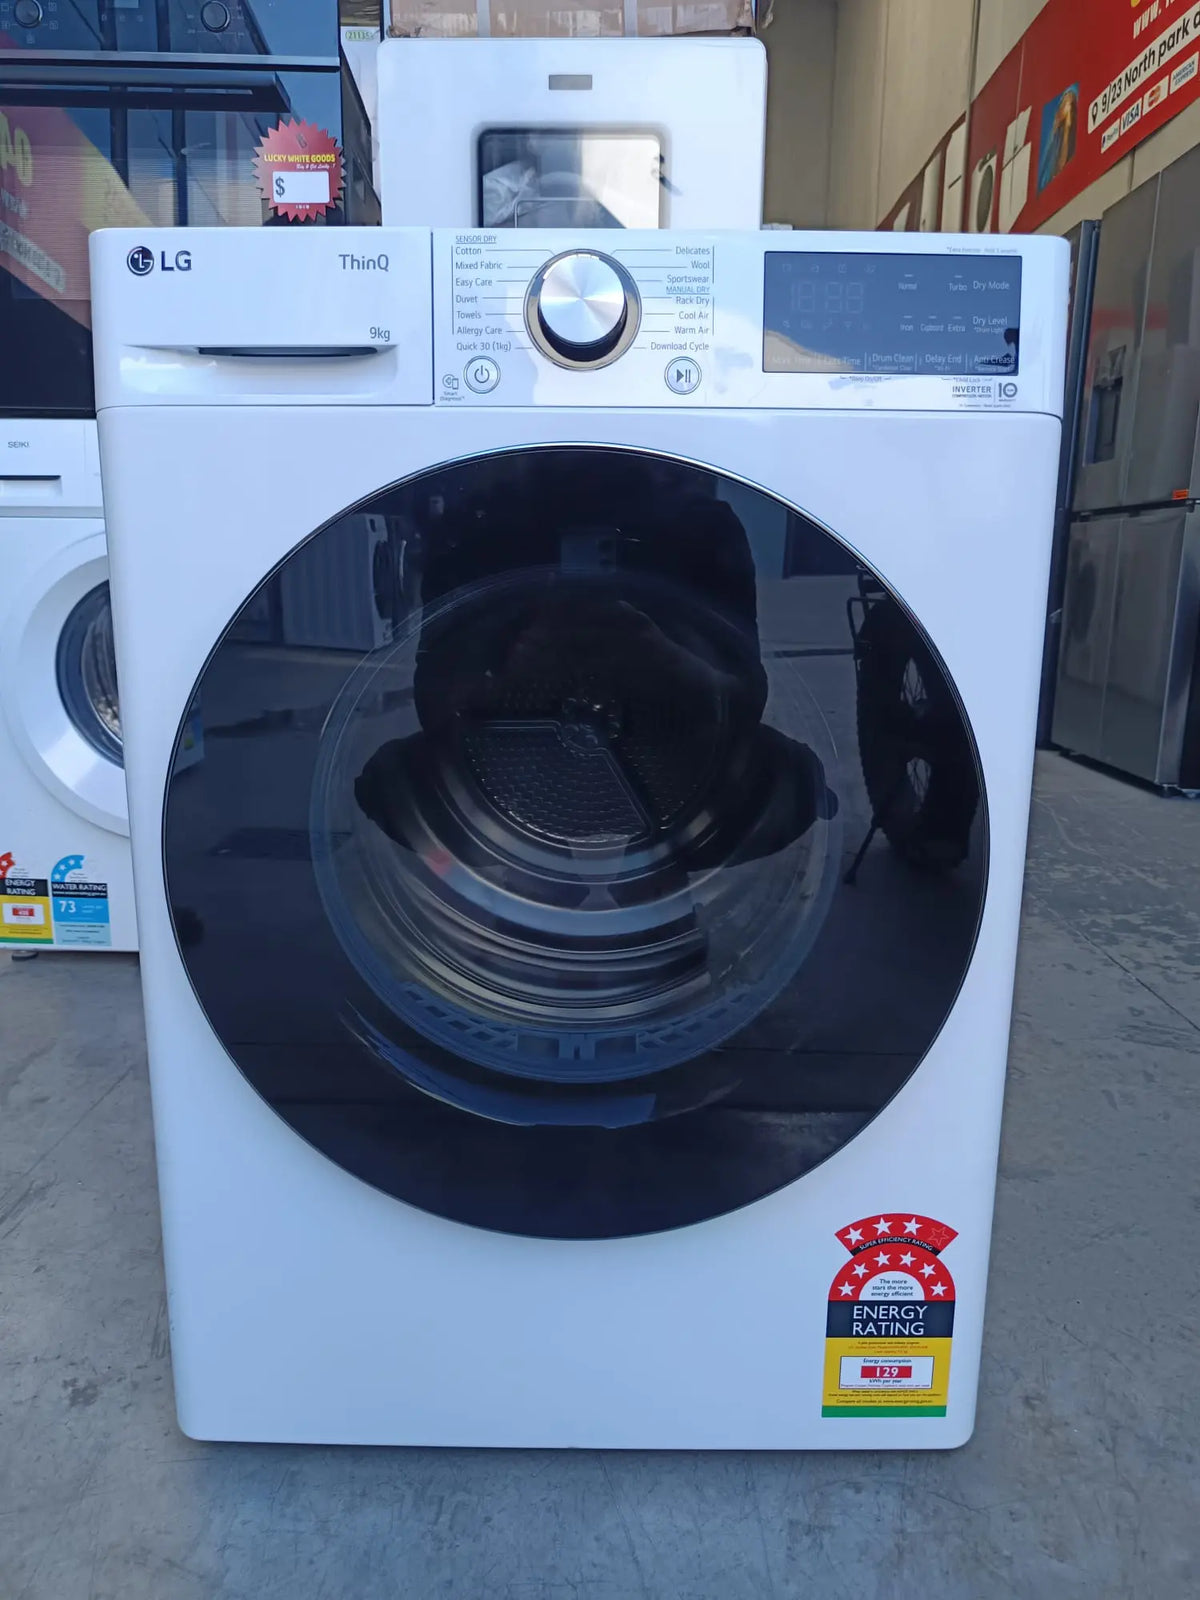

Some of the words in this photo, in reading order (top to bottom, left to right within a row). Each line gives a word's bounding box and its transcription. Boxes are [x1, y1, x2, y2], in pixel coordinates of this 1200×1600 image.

[1102, 78, 1122, 114] 9/23
[1124, 48, 1155, 91] North
[1158, 18, 1190, 67] park
[1123, 103, 1140, 130] VISA
[264, 154, 287, 162] LUCKY
[288, 154, 310, 163] WHITE
[311, 154, 336, 163] GOODS
[275, 176, 286, 198] $
[455, 247, 482, 255] Cotton
[675, 246, 711, 255] Delicates
[161, 250, 192, 271] LG
[339, 254, 390, 272] ThinQ
[455, 261, 479, 270] Mixed
[480, 261, 503, 270] Fabric
[691, 260, 710, 269] Wool
[455, 279, 473, 288] Easy
[667, 274, 710, 284] Sportswear
[948, 283, 968, 291] Turbo
[973, 281, 986, 290] Dry
[988, 281, 1010, 290] Mode
[455, 295, 479, 303] Duvet
[675, 296, 693, 305] Rack
[696, 296, 710, 307] Dry
[457, 311, 482, 319] Towels
[679, 311, 696, 320] Cool
[698, 311, 709, 320] Air
[973, 316, 986, 326] Dry
[988, 316, 1008, 325] Level
[457, 326, 483, 336] Allergy
[485, 326, 503, 334] Care
[674, 326, 696, 334] Warm
[698, 326, 709, 334] Air
[948, 324, 966, 332] Extra
[369, 327, 391, 343] 9kg
[457, 342, 478, 351] Quick
[480, 342, 490, 350] 30
[492, 341, 512, 352] (1kg)
[650, 341, 687, 351] Download
[689, 341, 710, 352] Cycle
[872, 354, 892, 362] Drum
[894, 354, 914, 363] Clean
[925, 354, 945, 364] Delay
[948, 354, 961, 363] End
[974, 355, 989, 364] Anti
[991, 355, 1015, 364] Crease
[952, 385, 992, 393] INVERTER
[59, 900, 76, 913] 73
[859, 1240, 877, 1250] SUPER
[878, 1236, 911, 1244] EFFICIENCY
[911, 1239, 933, 1251] RATING
[853, 1305, 928, 1319] ENERGY
[852, 1322, 925, 1336] RATING
[876, 1367, 899, 1377] 129
